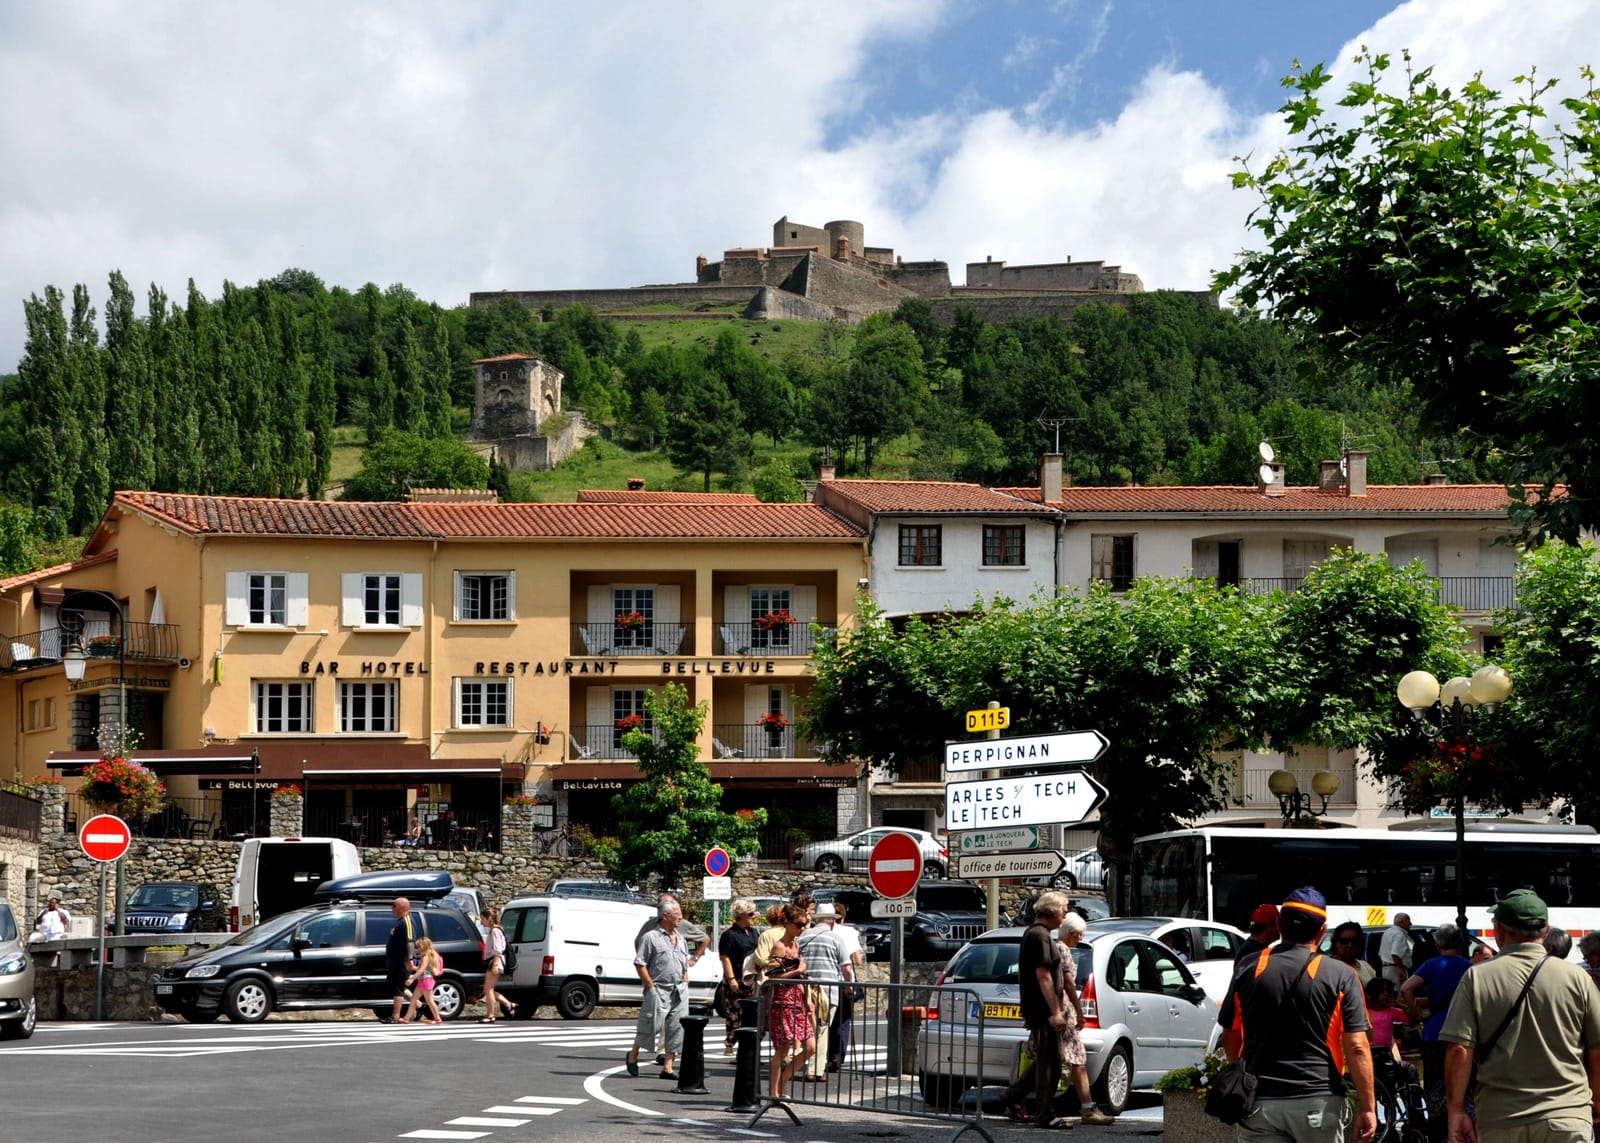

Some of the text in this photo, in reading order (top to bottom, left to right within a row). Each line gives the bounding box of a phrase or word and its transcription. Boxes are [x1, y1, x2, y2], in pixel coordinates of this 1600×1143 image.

[300, 661, 776, 675] BAR HOTEL RESTAURANT BELLEVUE
[968, 711, 1005, 729] D 115
[952, 743, 1050, 765] PERPIGNAN
[209, 780, 279, 789] Le Bellevue
[563, 781, 622, 790] Bellavista
[952, 787, 1004, 804] ARLES
[1034, 780, 1077, 798] TECH
[952, 805, 1022, 823] LE TECH
[986, 832, 994, 840] LA
[986, 840, 994, 848] LE
[963, 858, 1053, 873] office de tourisme
[885, 903, 903, 913] 100
